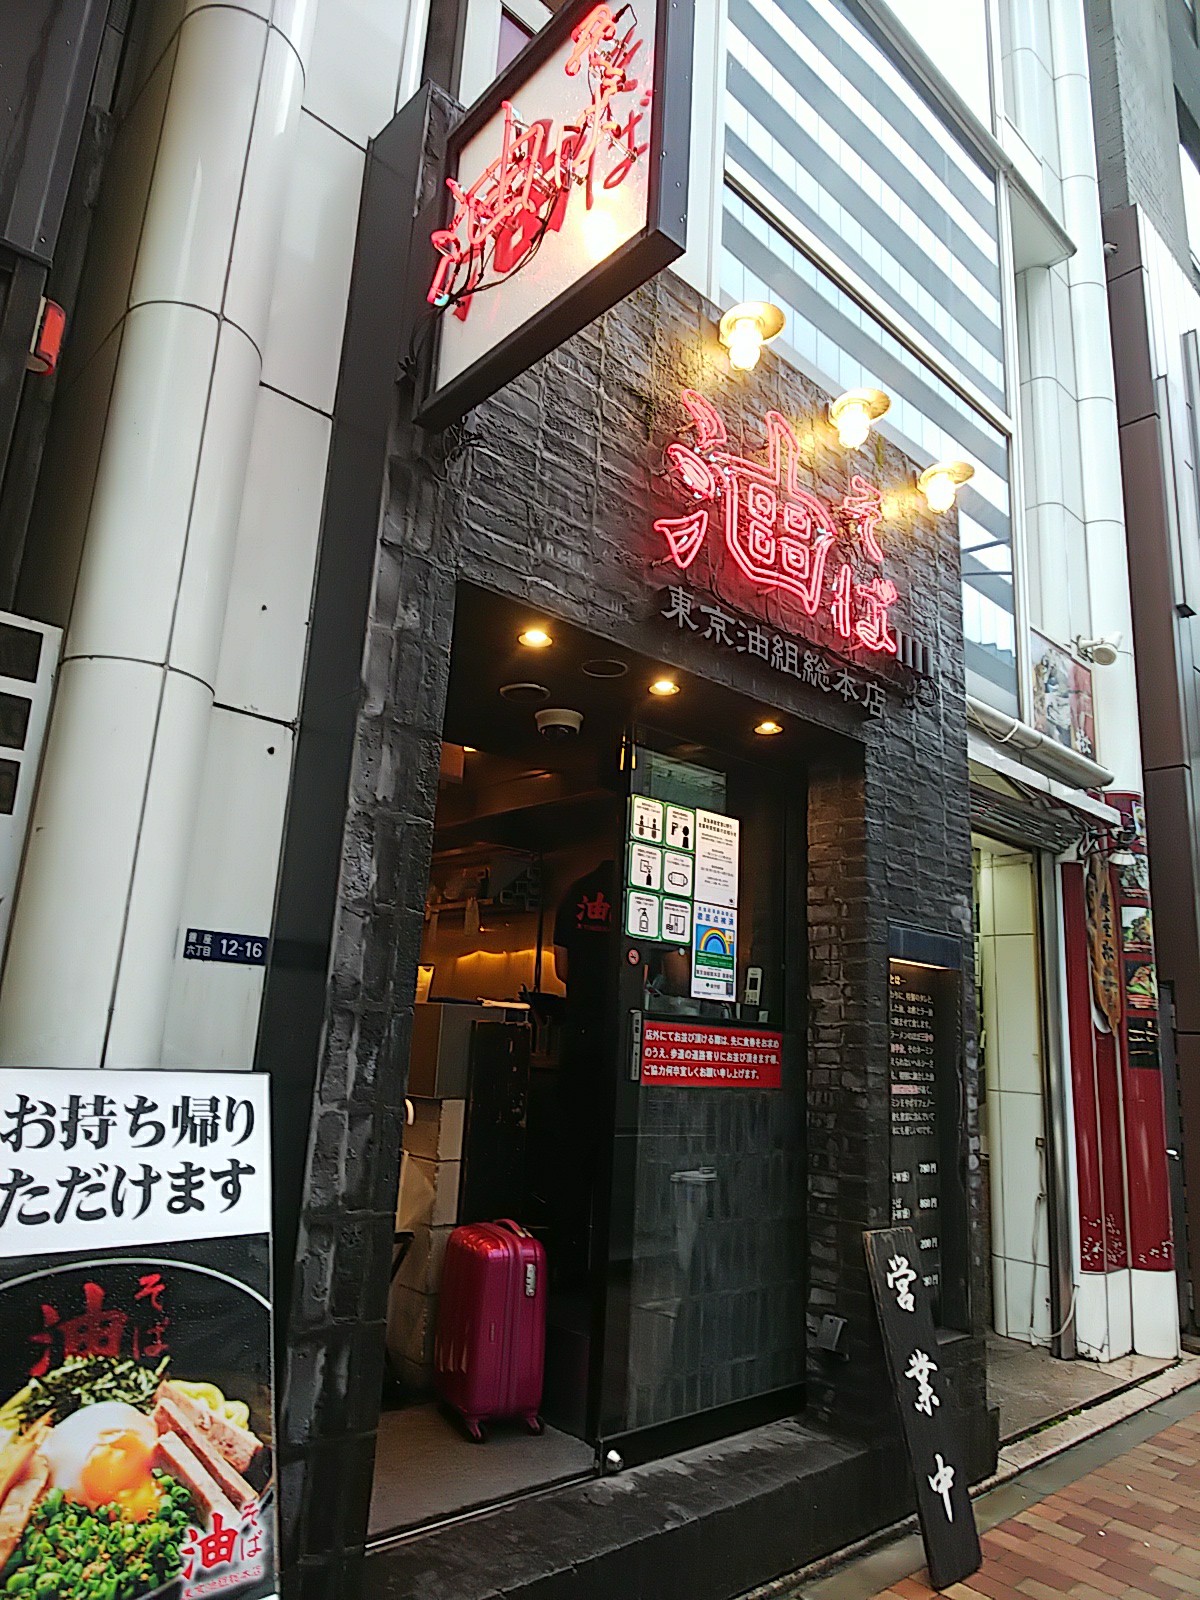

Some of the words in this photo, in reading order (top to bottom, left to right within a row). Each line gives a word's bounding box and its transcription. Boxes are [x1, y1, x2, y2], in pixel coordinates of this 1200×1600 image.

[660, 584, 888, 719] 東京油組総本店
[185, 944, 211, 957] 六丁目
[220, 939, 263, 958] 12-16
[0, 1093, 255, 1152] お持ち帰り
[0, 1158, 256, 1228] ただけます
[886, 1254, 956, 1523] 営業中
